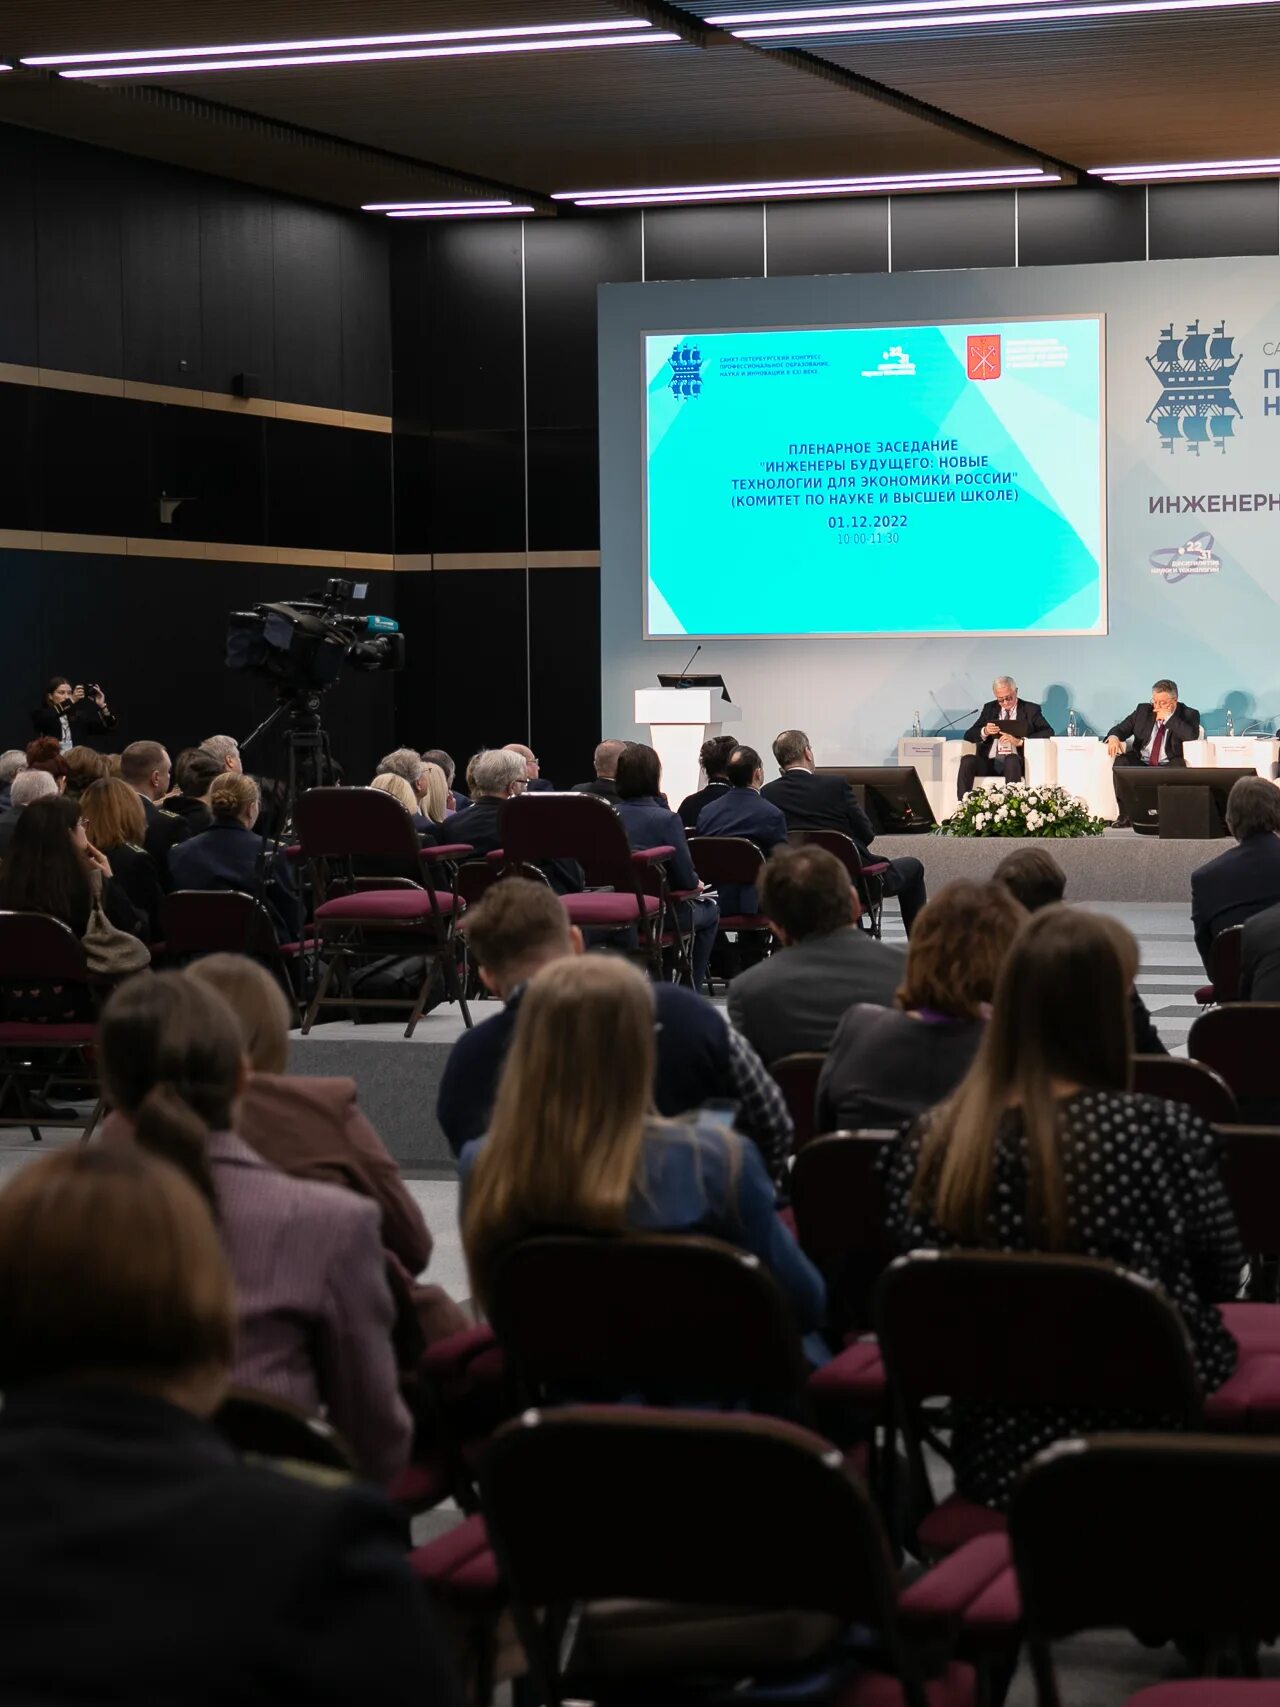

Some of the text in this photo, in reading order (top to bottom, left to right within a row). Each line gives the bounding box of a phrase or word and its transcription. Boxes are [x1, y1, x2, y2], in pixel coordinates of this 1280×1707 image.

[789, 440, 958, 455] ПЛЕНАРНОЕ ЗАСЕДАНИЕ
[760, 456, 988, 472] "ИНЖЕНЕРЫ БУДУЩЕГО: НОВЫЕ
[732, 472, 1018, 490] ТЕХНОЛОГИИ ДЛЯ ЭКОНОМИКИ РОССИИ"
[732, 489, 1019, 508] (КОМИТЕТ ПО НАУКЕ И ВЫСШЕЙ ШКОЛЕ)
[828, 515, 908, 528] 01.12.2022
[1186, 541, 1203, 552] 22
